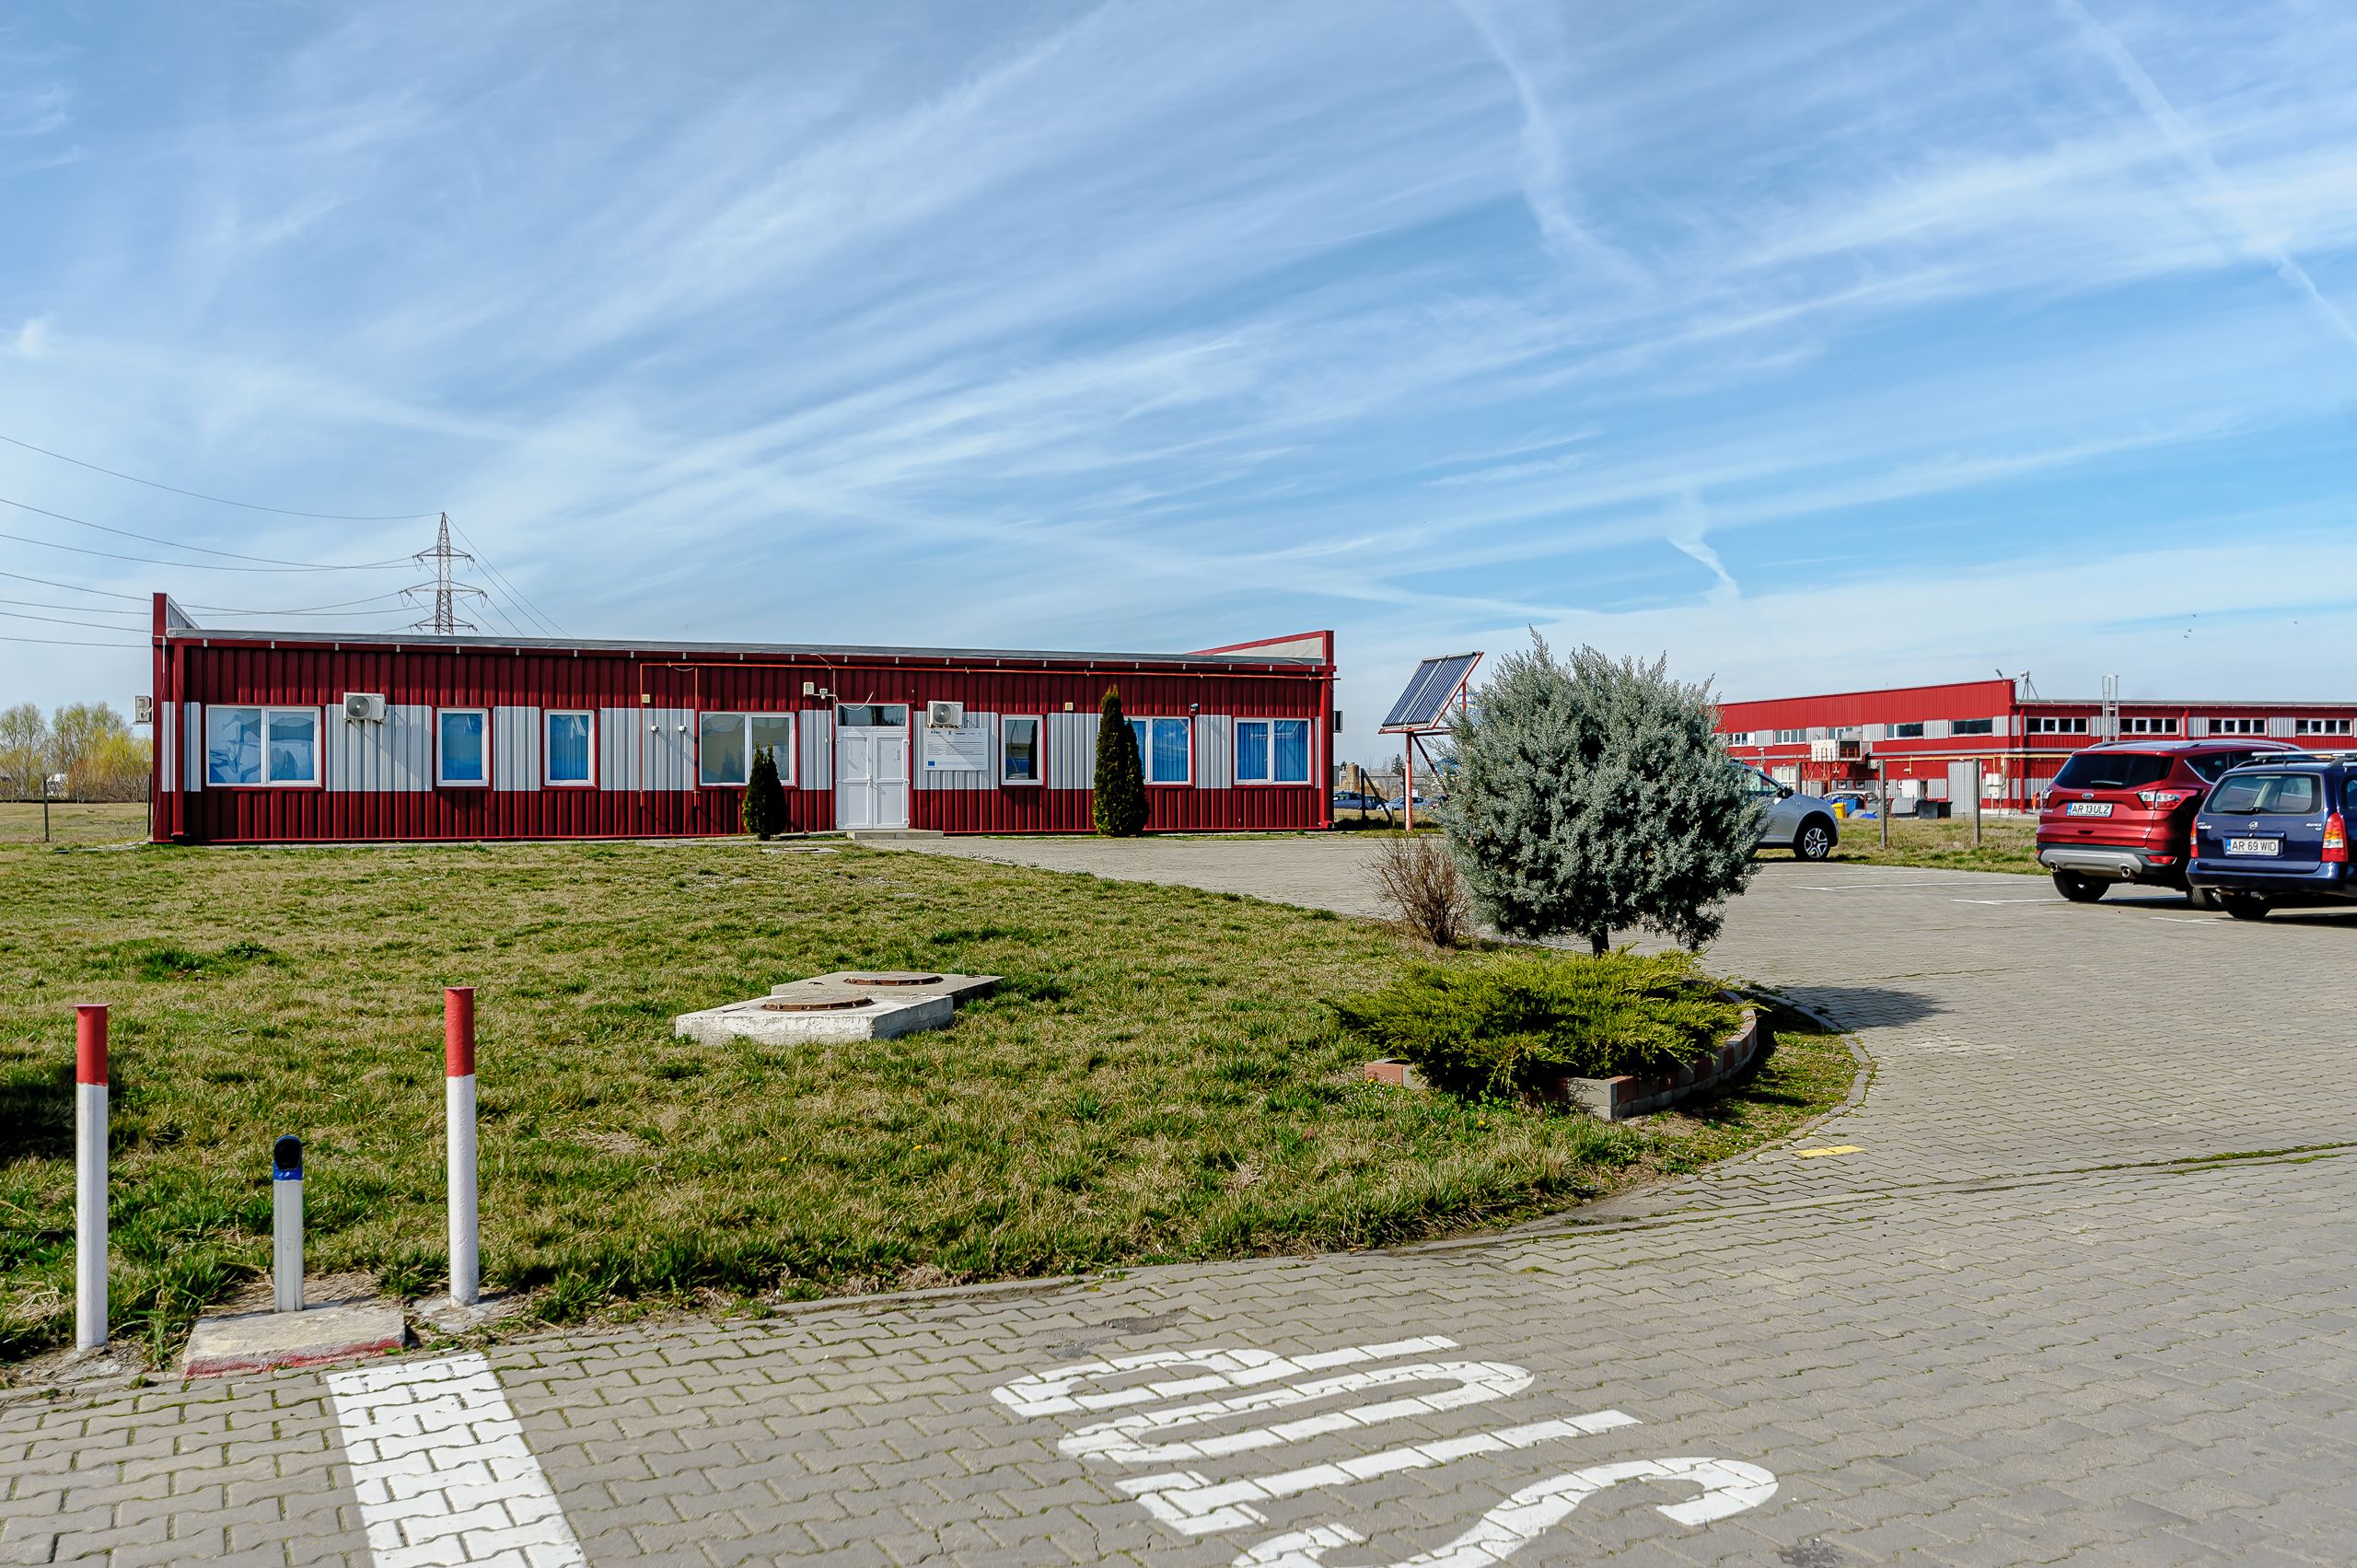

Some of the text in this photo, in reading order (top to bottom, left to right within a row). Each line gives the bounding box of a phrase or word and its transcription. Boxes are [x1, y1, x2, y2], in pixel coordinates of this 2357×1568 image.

[2072, 804, 2084, 814] AR
[2232, 841, 2246, 851] AR
[2247, 841, 2258, 851] 69
[992, 1336, 1778, 1568] STOP
